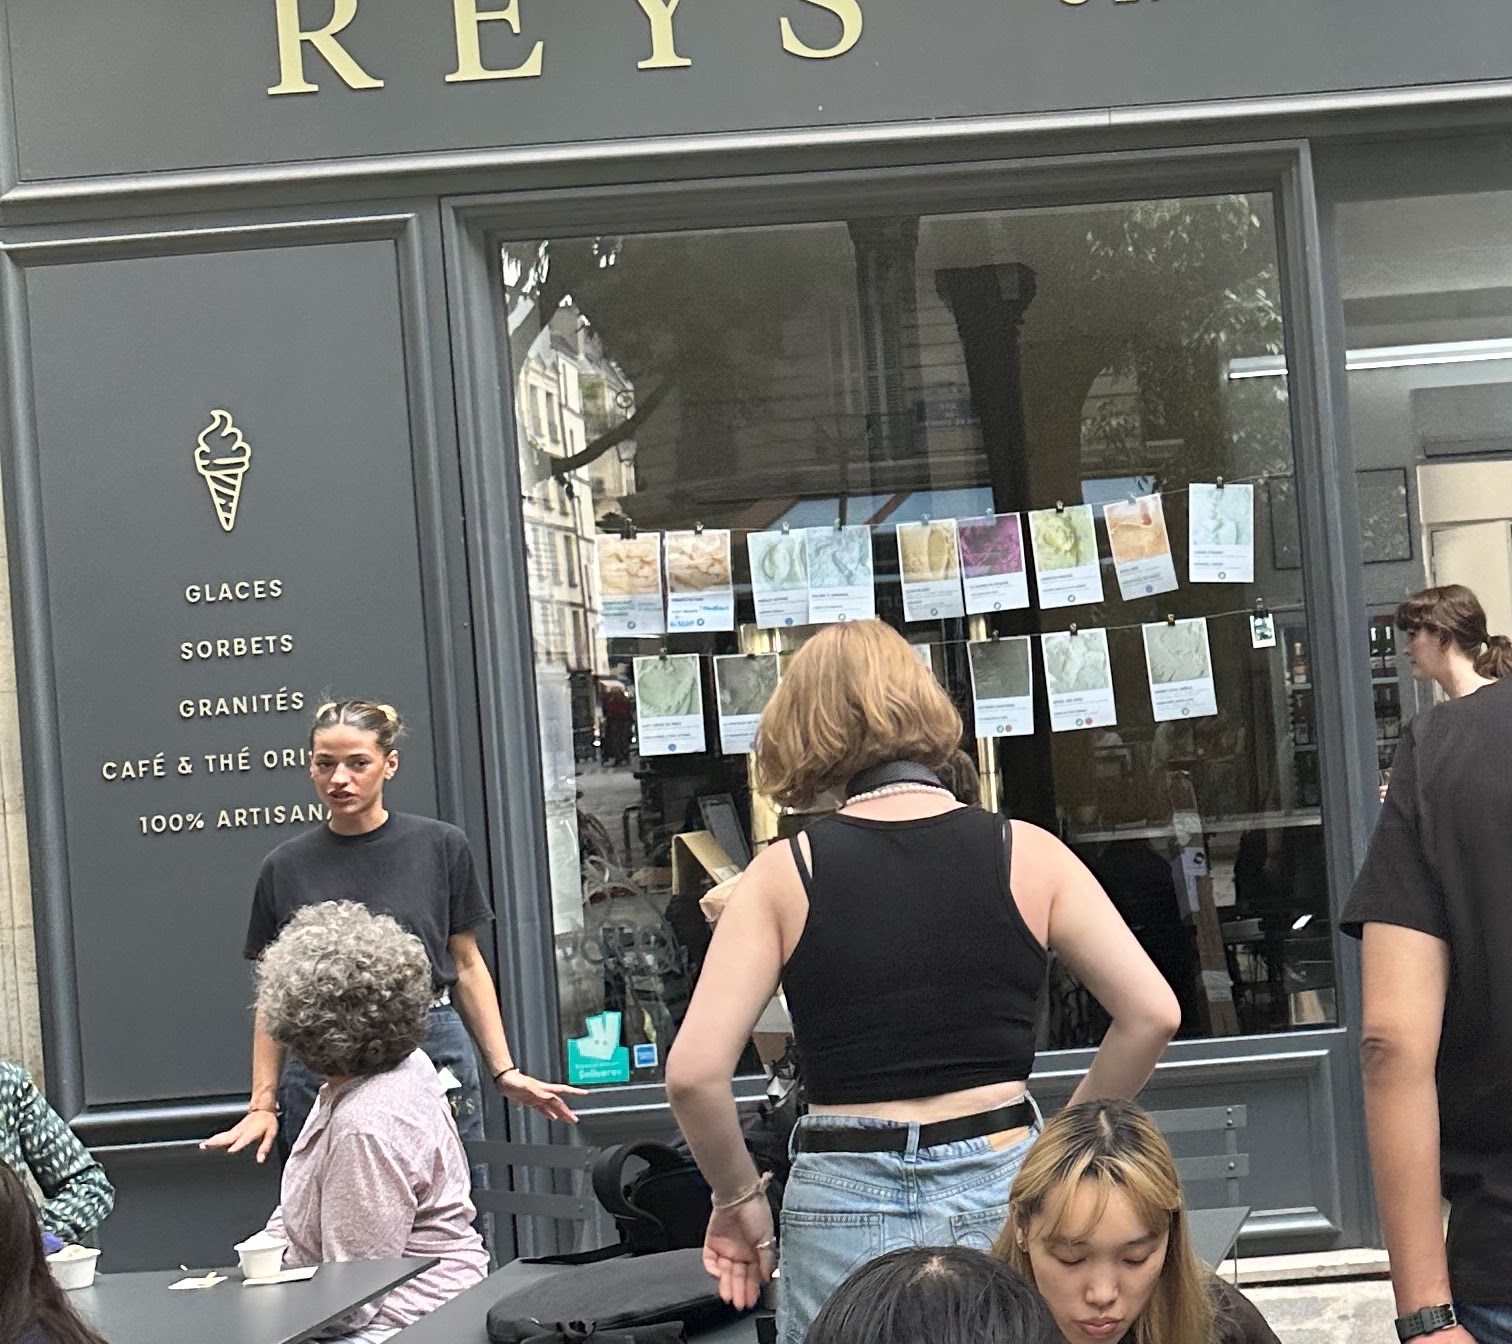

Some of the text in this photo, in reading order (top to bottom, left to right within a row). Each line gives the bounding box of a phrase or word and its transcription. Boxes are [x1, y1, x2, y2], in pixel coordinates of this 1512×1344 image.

[185, 578, 284, 604] GLACES
[180, 633, 294, 661] SORBETS
[178, 686, 305, 719] GRANITÉS
[102, 747, 313, 781] CAFÉ & THÉ ORI
[139, 812, 206, 835] 100%
